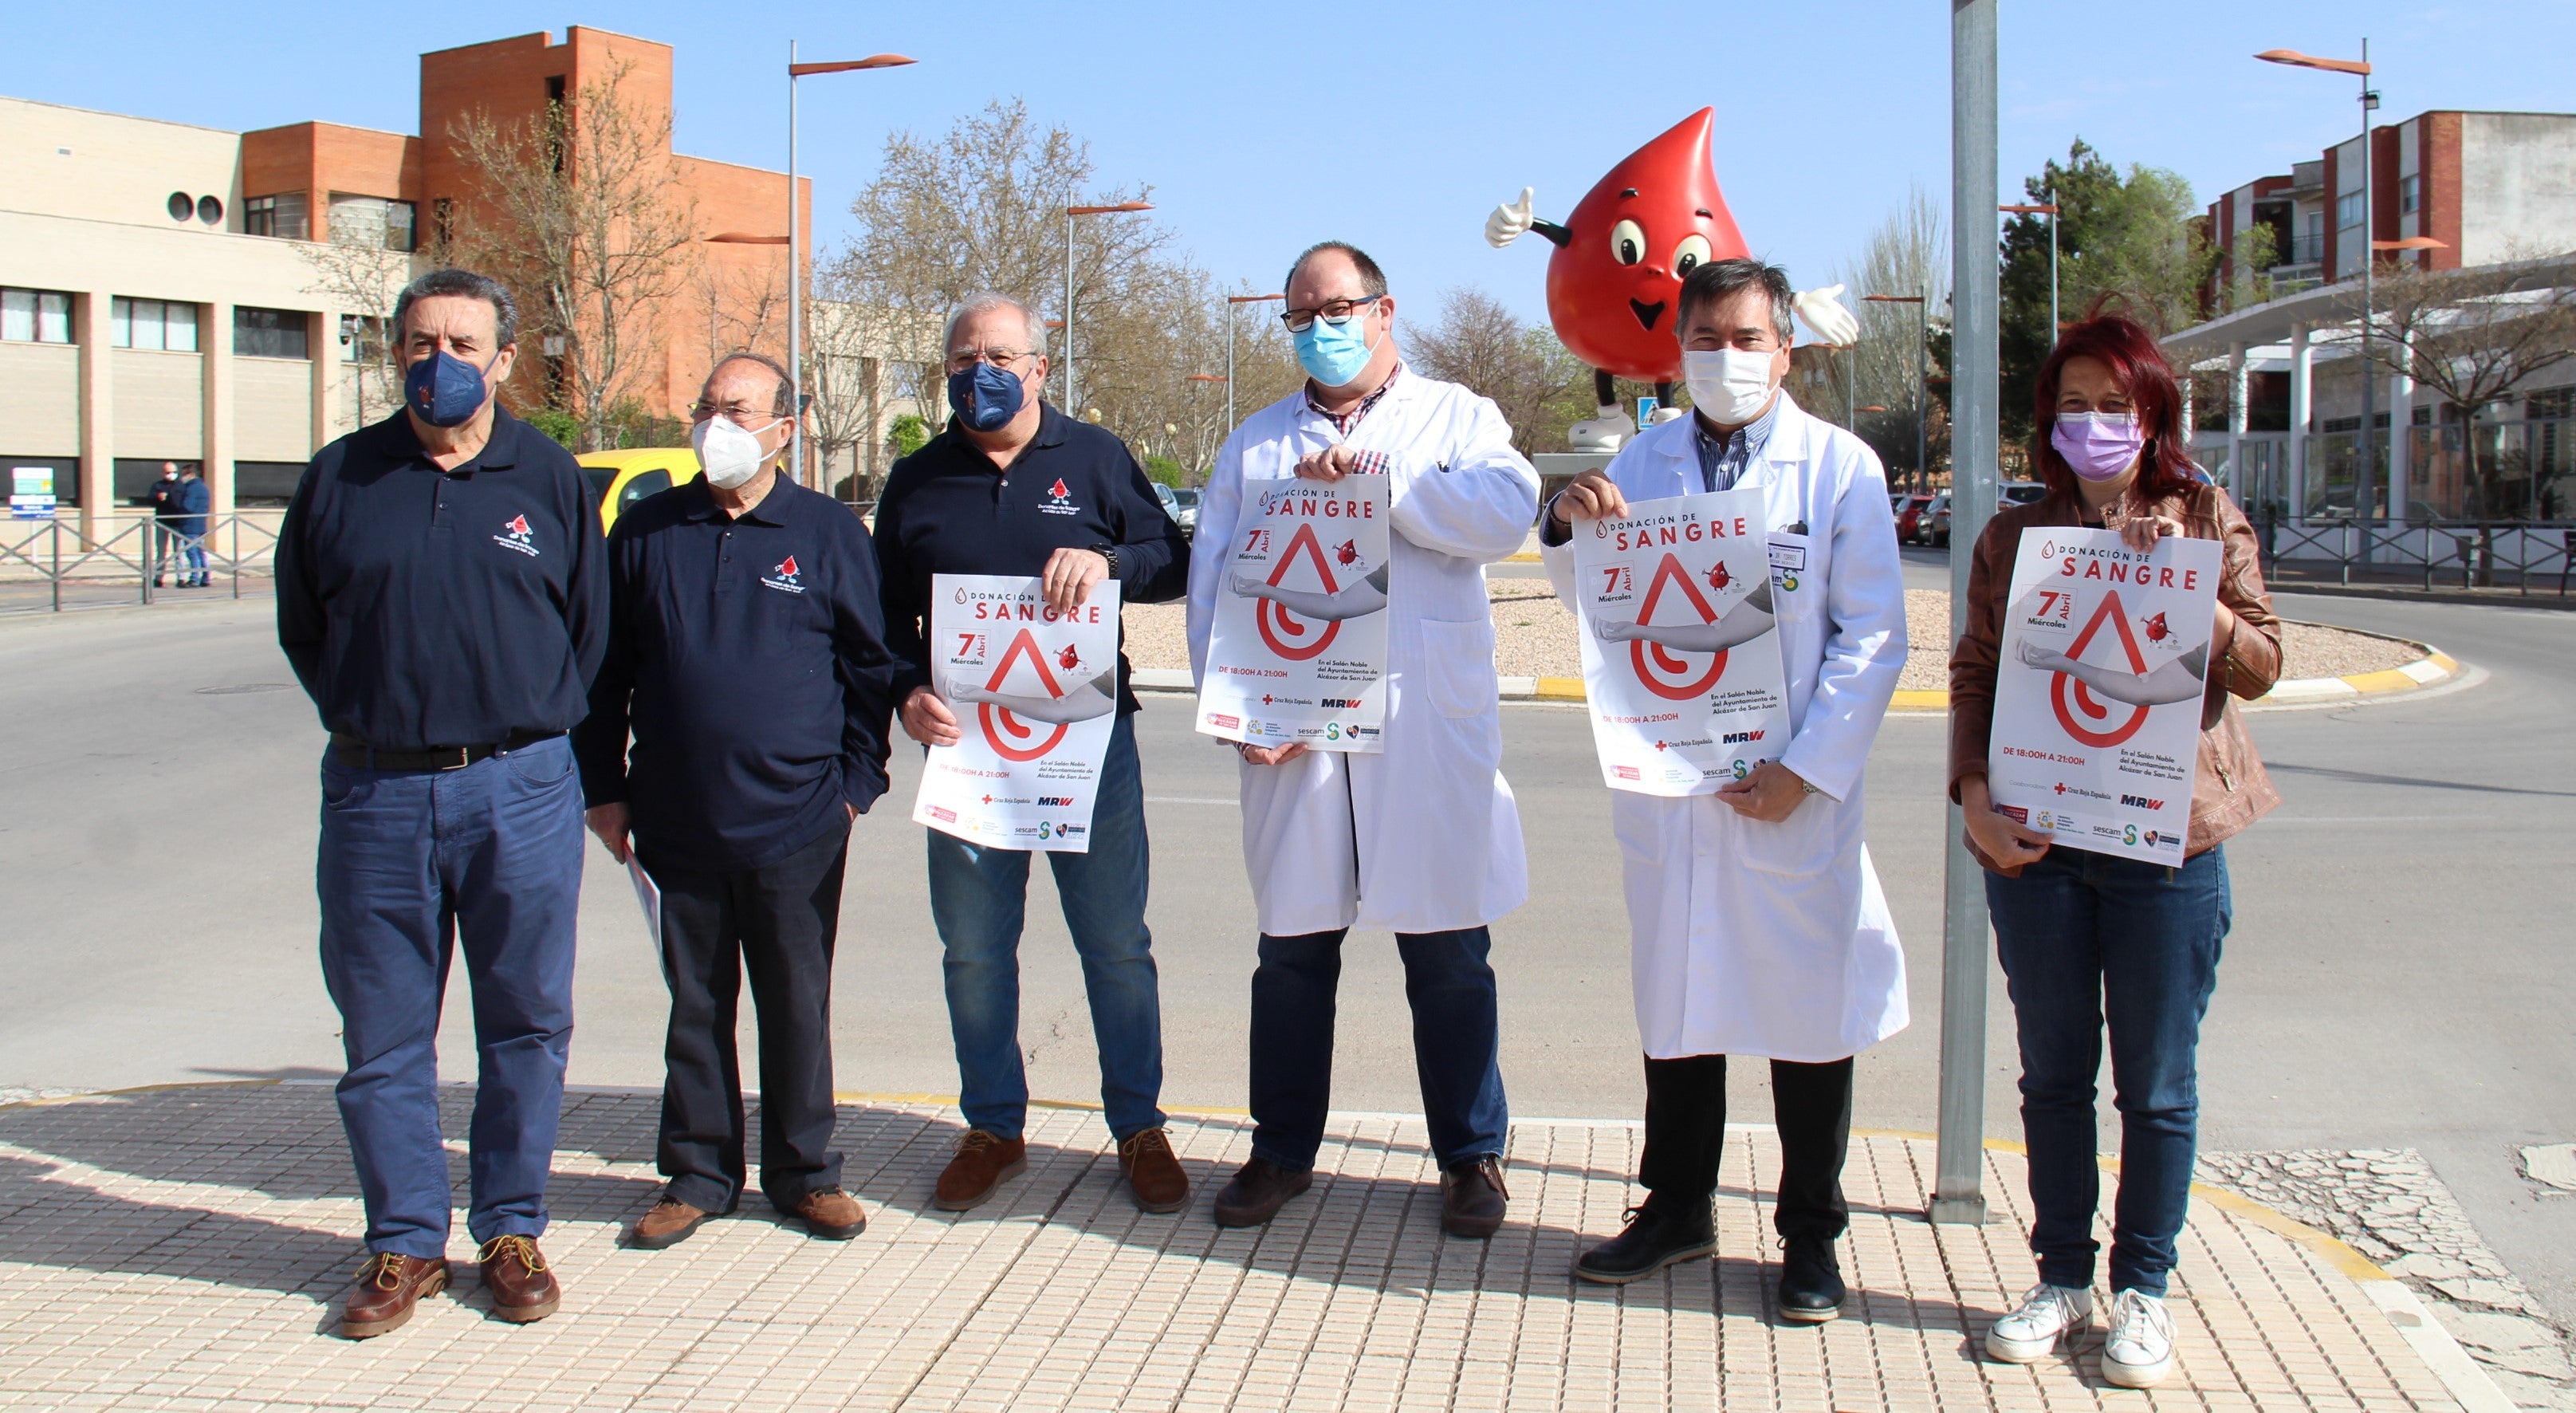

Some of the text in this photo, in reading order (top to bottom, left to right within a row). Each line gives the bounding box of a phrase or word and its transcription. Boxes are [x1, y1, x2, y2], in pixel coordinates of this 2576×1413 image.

[1265, 498, 1372, 519] SANGRE
[1610, 513, 1696, 531] DONACIÓN DE
[1245, 529, 1262, 552] 7
[1261, 529, 1270, 553] Abril
[1616, 518, 1746, 551] SANGRE
[2059, 545, 2150, 562] DONACIÓN DE
[1603, 567, 1620, 593] 7
[1622, 567, 1632, 591] Abril
[2061, 557, 2197, 590] SANGRE
[970, 592, 1034, 602] DONACIÓN
[1599, 593, 1631, 603] Miércoles
[2036, 591, 2059, 616] 7
[975, 602, 1099, 624] SANGRE
[2059, 593, 2071, 620] Abril
[2027, 617, 2066, 628] Miércoles
[958, 633, 976, 656] 7
[977, 635, 985, 658] Abril
[1321, 699, 1362, 708] MRW
[1723, 697, 1768, 707] Ayuntamiento
[1650, 713, 1678, 722] 21:00H
[1723, 730, 1765, 744] MRW
[2003, 746, 2014, 755] DE
[2016, 749, 2047, 760] 18:00H
[2057, 754, 2085, 766] 21:00H
[2155, 754, 2175, 763] Noble
[2130, 759, 2176, 771] Ayuntamiento
[1037, 797, 1074, 806] MRW
[2079, 789, 2090, 797] Roja
[2090, 791, 2112, 800] Española
[2120, 794, 2165, 810] MRW
[2093, 825, 2121, 836] sescam
